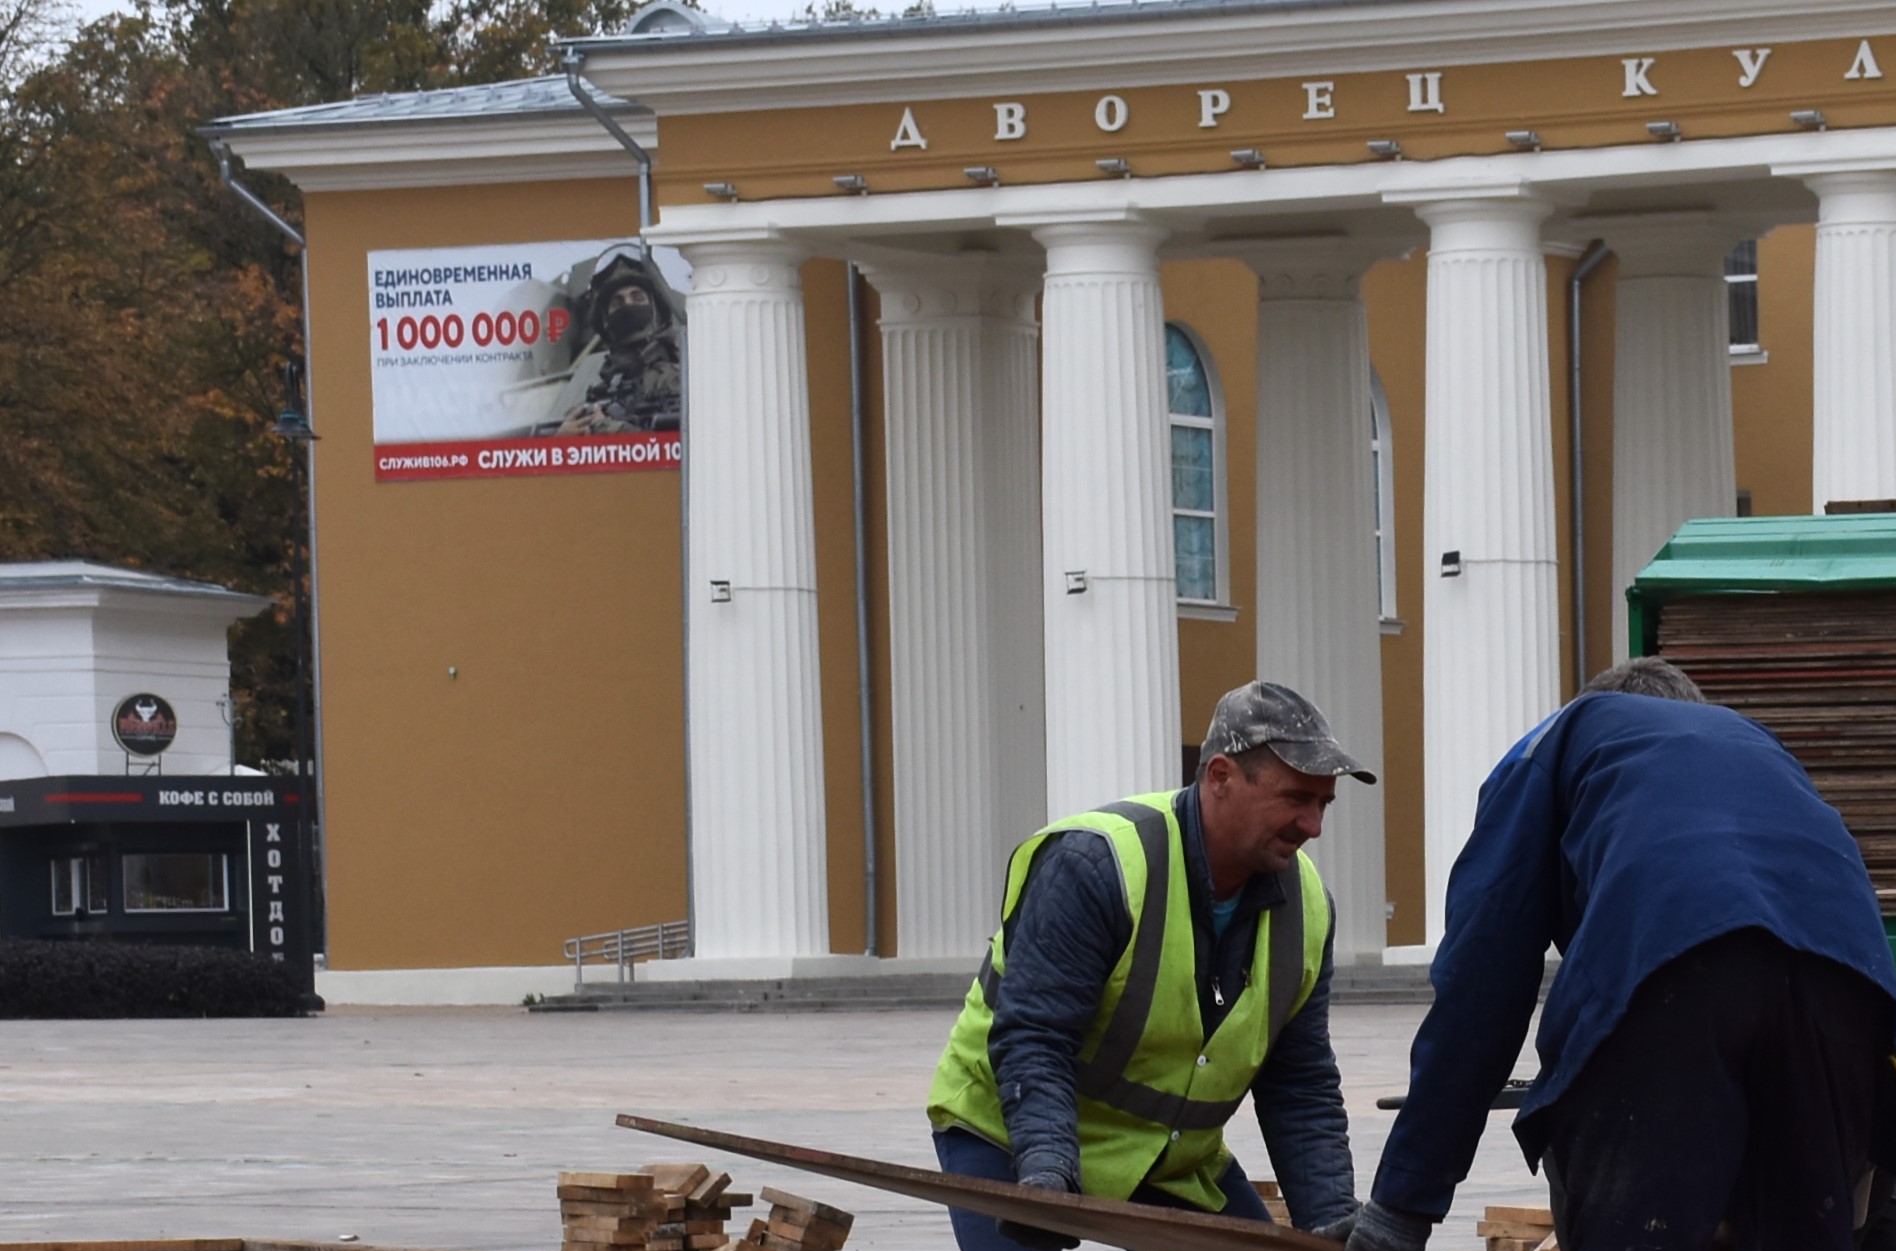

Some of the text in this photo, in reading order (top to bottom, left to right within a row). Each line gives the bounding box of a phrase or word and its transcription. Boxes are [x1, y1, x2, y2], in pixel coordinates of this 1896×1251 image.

[891, 74, 1444, 150] ДВОРЕЦ
[375, 263, 532, 288] ЕДИНОВРЕМЕННАЯ
[375, 290, 453, 308] ВЫПЛАТА
[472, 310, 540, 347] 000
[377, 351, 534, 368] ПРИ ЗАКЛЮЧЕНИИ КОНТРАКТА
[379, 454, 469, 470] СЛУЖИВ106.РФ
[478, 448, 548, 468] СЛУЖИ
[552, 449, 563, 465] В
[567, 437, 660, 465] ЭЛИТНОЙ
[159, 789, 274, 806] КОФЕ С СОБОЙ
